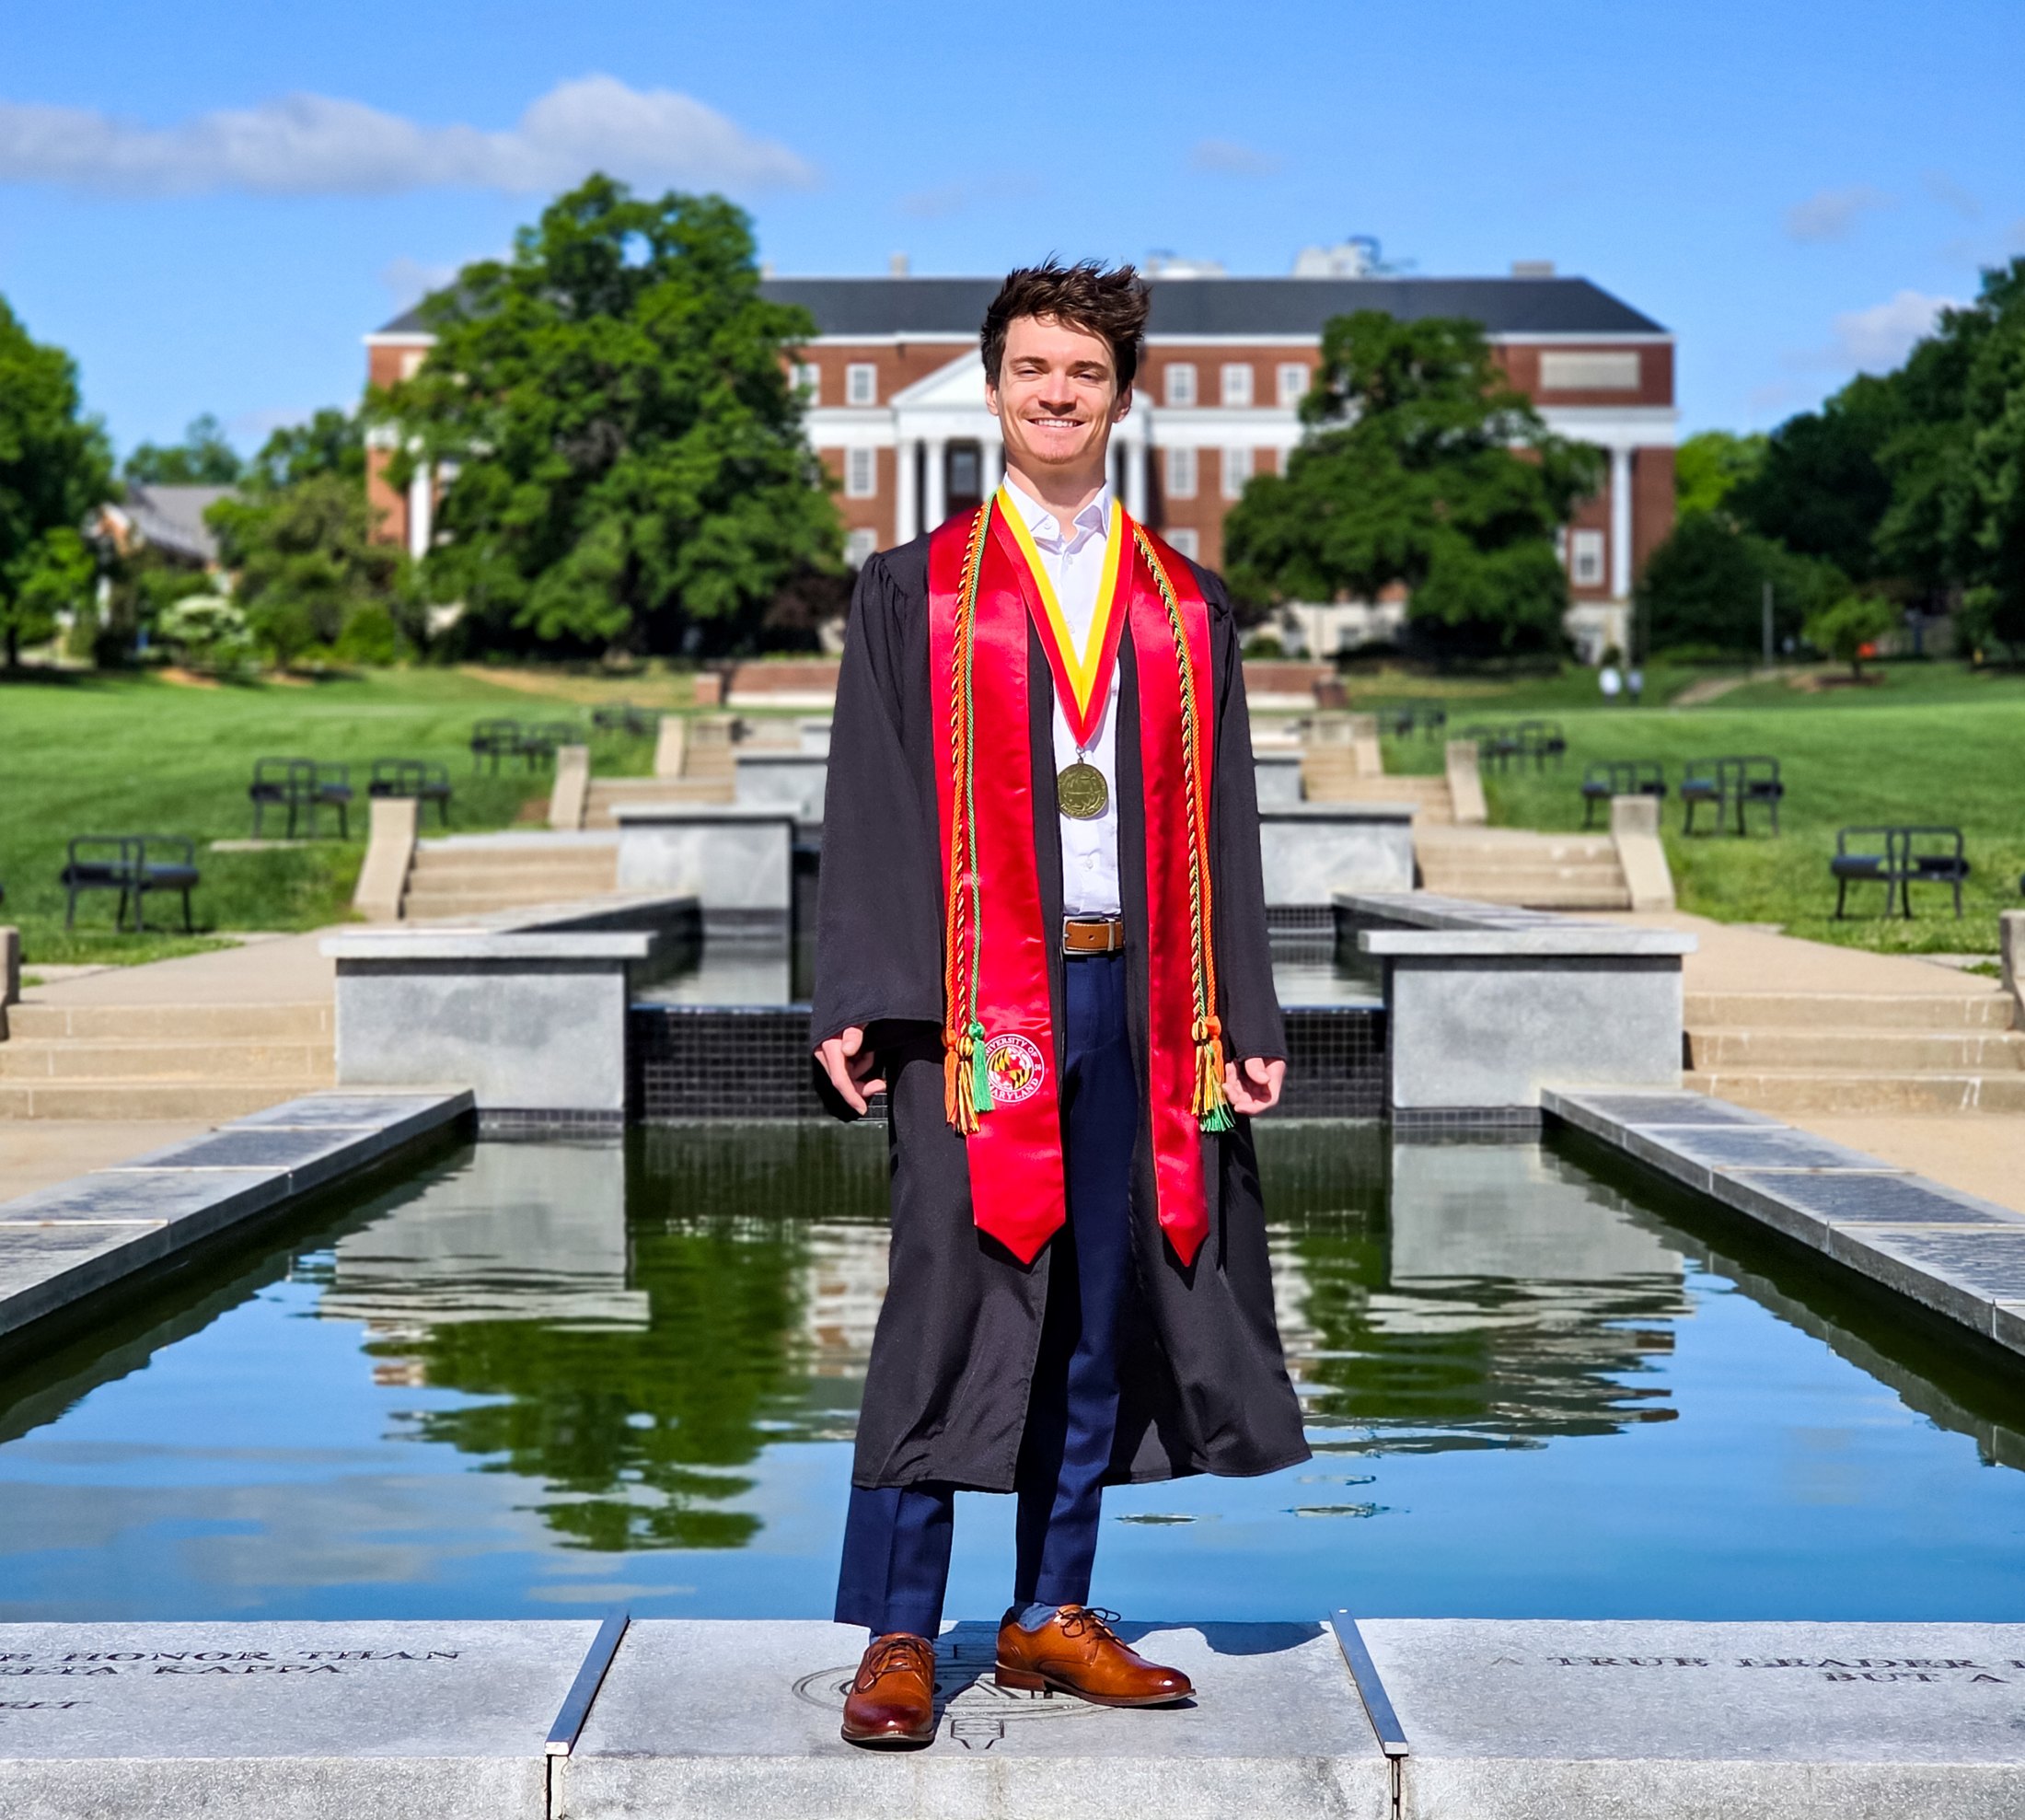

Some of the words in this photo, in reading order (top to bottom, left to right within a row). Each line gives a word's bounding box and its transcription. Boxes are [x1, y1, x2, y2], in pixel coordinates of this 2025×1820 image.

[986, 1037, 1027, 1057] NIVERSITY
[1027, 1047, 1039, 1058] OF
[61, 1652, 275, 1662] HONOR
[298, 1651, 466, 1661] THAN
[1545, 1656, 1710, 1666] TRUE
[1736, 1658, 1988, 1669] LEADER
[153, 1664, 345, 1675] KAPPA
[1822, 1672, 1942, 1683] BUT
[1968, 1673, 2011, 1684] A
